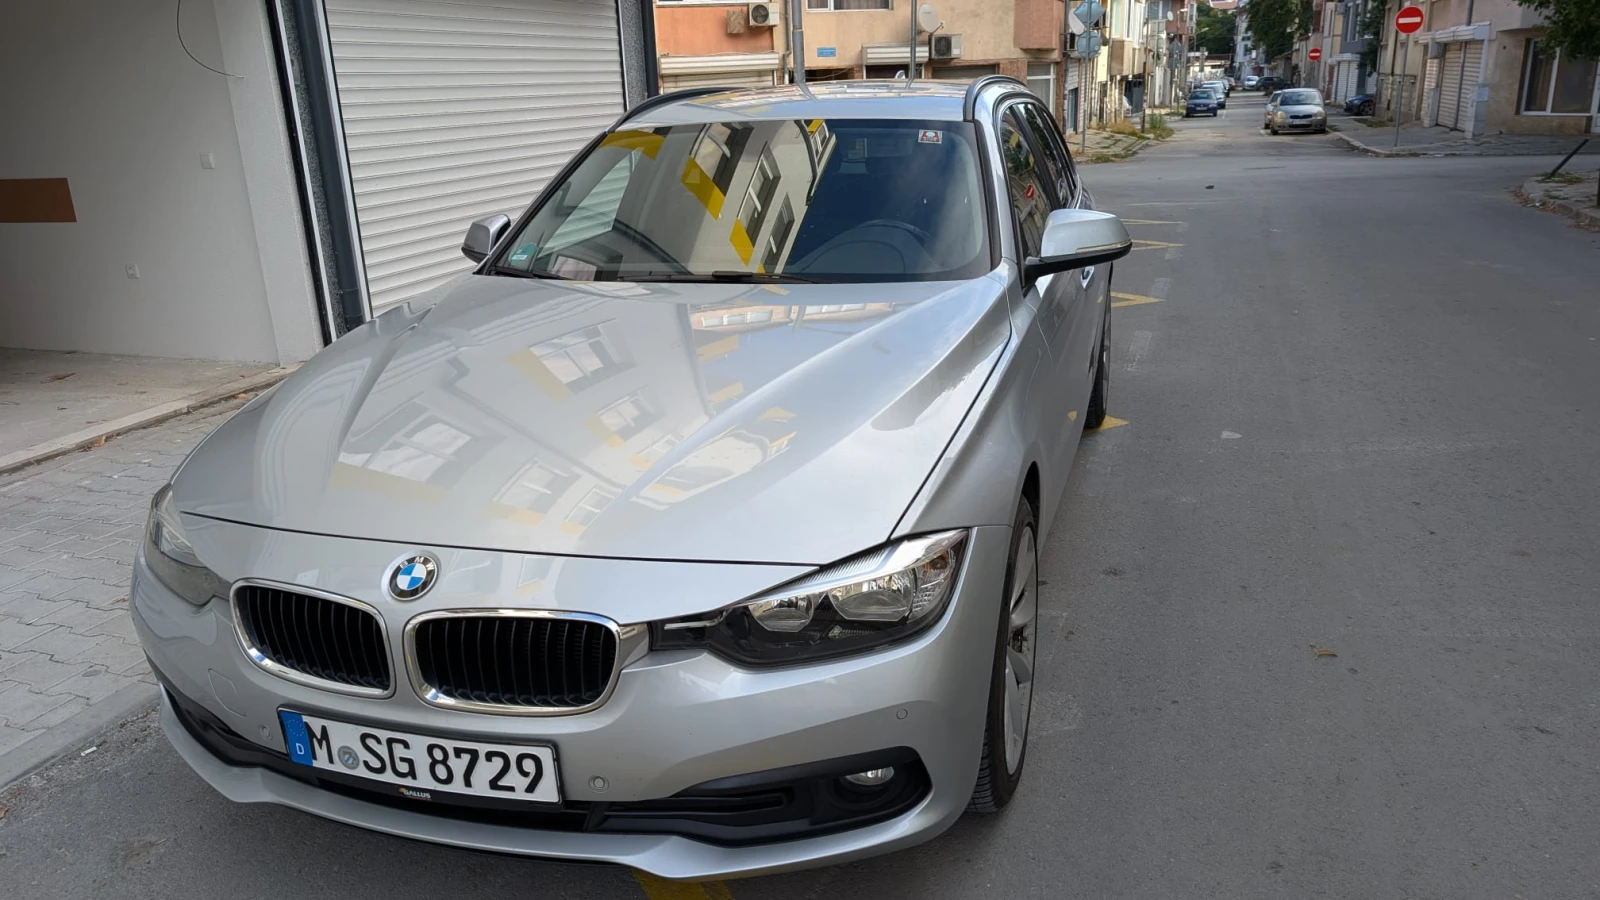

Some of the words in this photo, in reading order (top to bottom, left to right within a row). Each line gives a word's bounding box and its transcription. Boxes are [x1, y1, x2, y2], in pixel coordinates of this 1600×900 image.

[399, 556, 435, 571] BMW
[296, 742, 305, 755] D
[303, 721, 335, 765] M
[359, 732, 418, 781] SG
[426, 743, 544, 794] 8729
[403, 789, 431, 799] GALLUS
